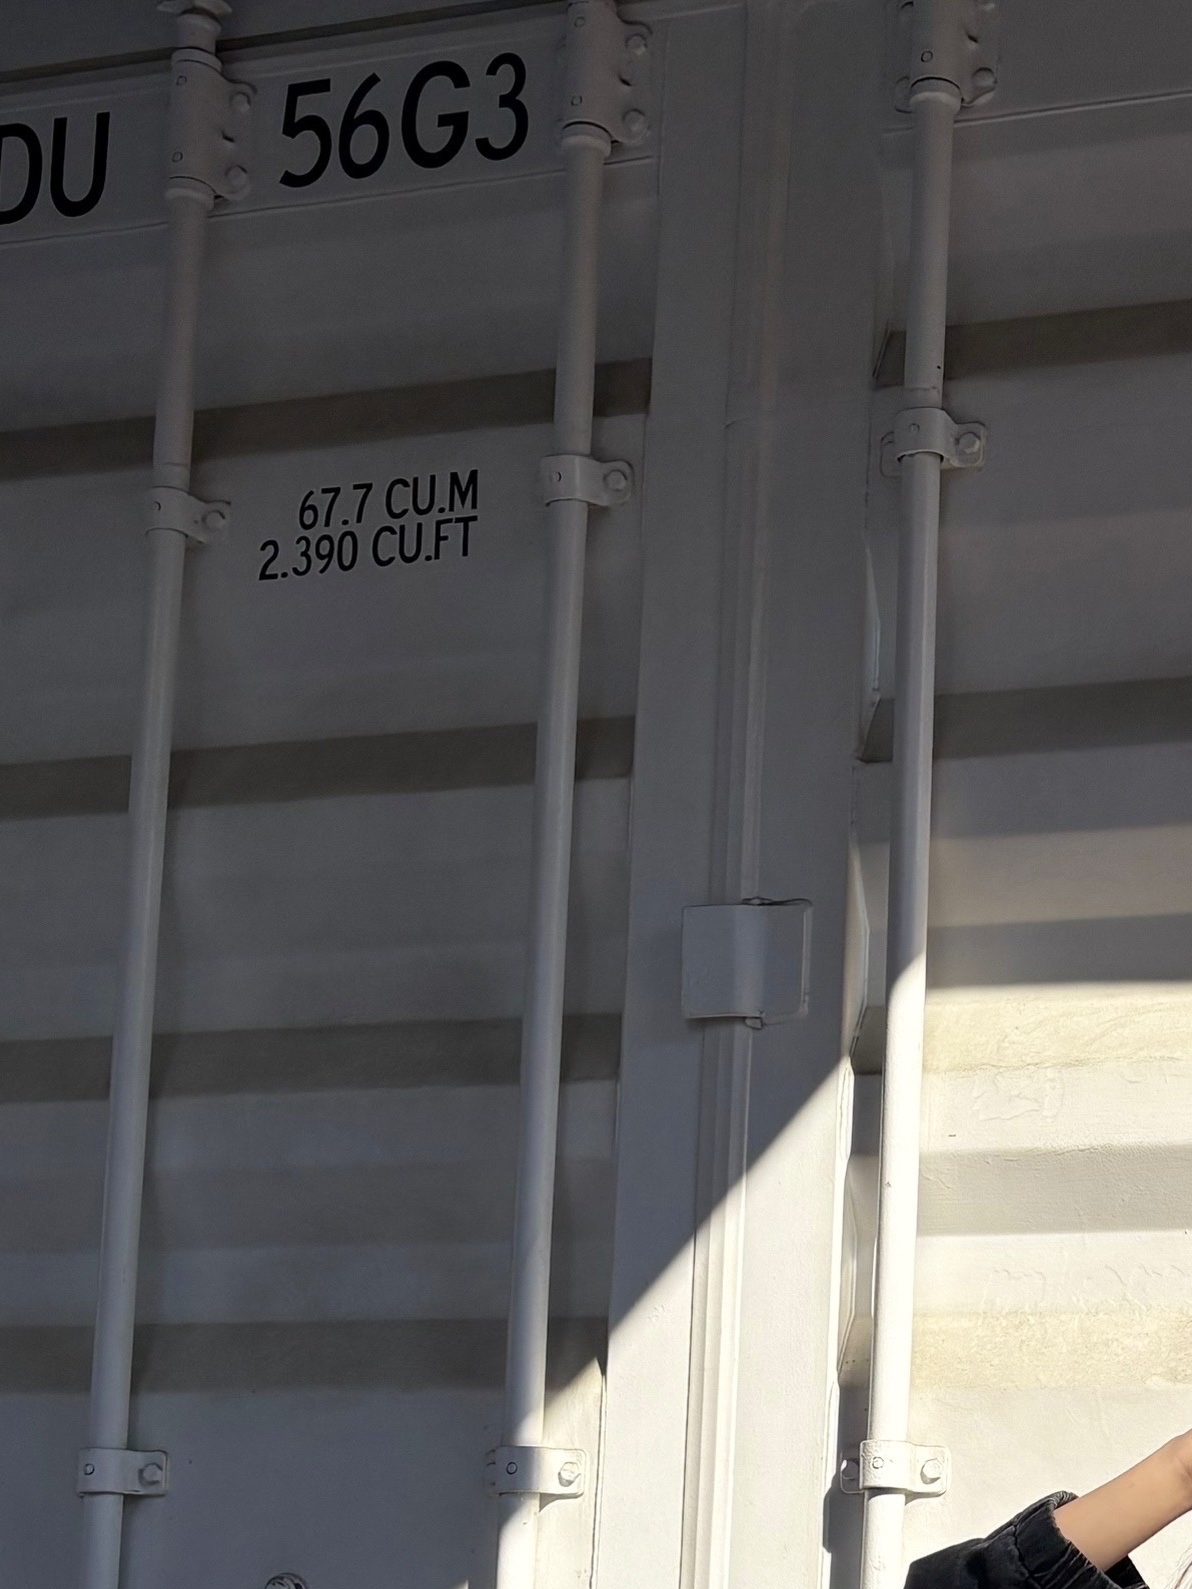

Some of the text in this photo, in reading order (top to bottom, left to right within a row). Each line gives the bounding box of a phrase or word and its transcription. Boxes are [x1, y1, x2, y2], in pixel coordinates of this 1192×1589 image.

[0, 52, 529, 226] DU 56G3
[299, 469, 479, 531] 67.7 CU.M
[258, 515, 479, 581] 2.390 CU.FT
